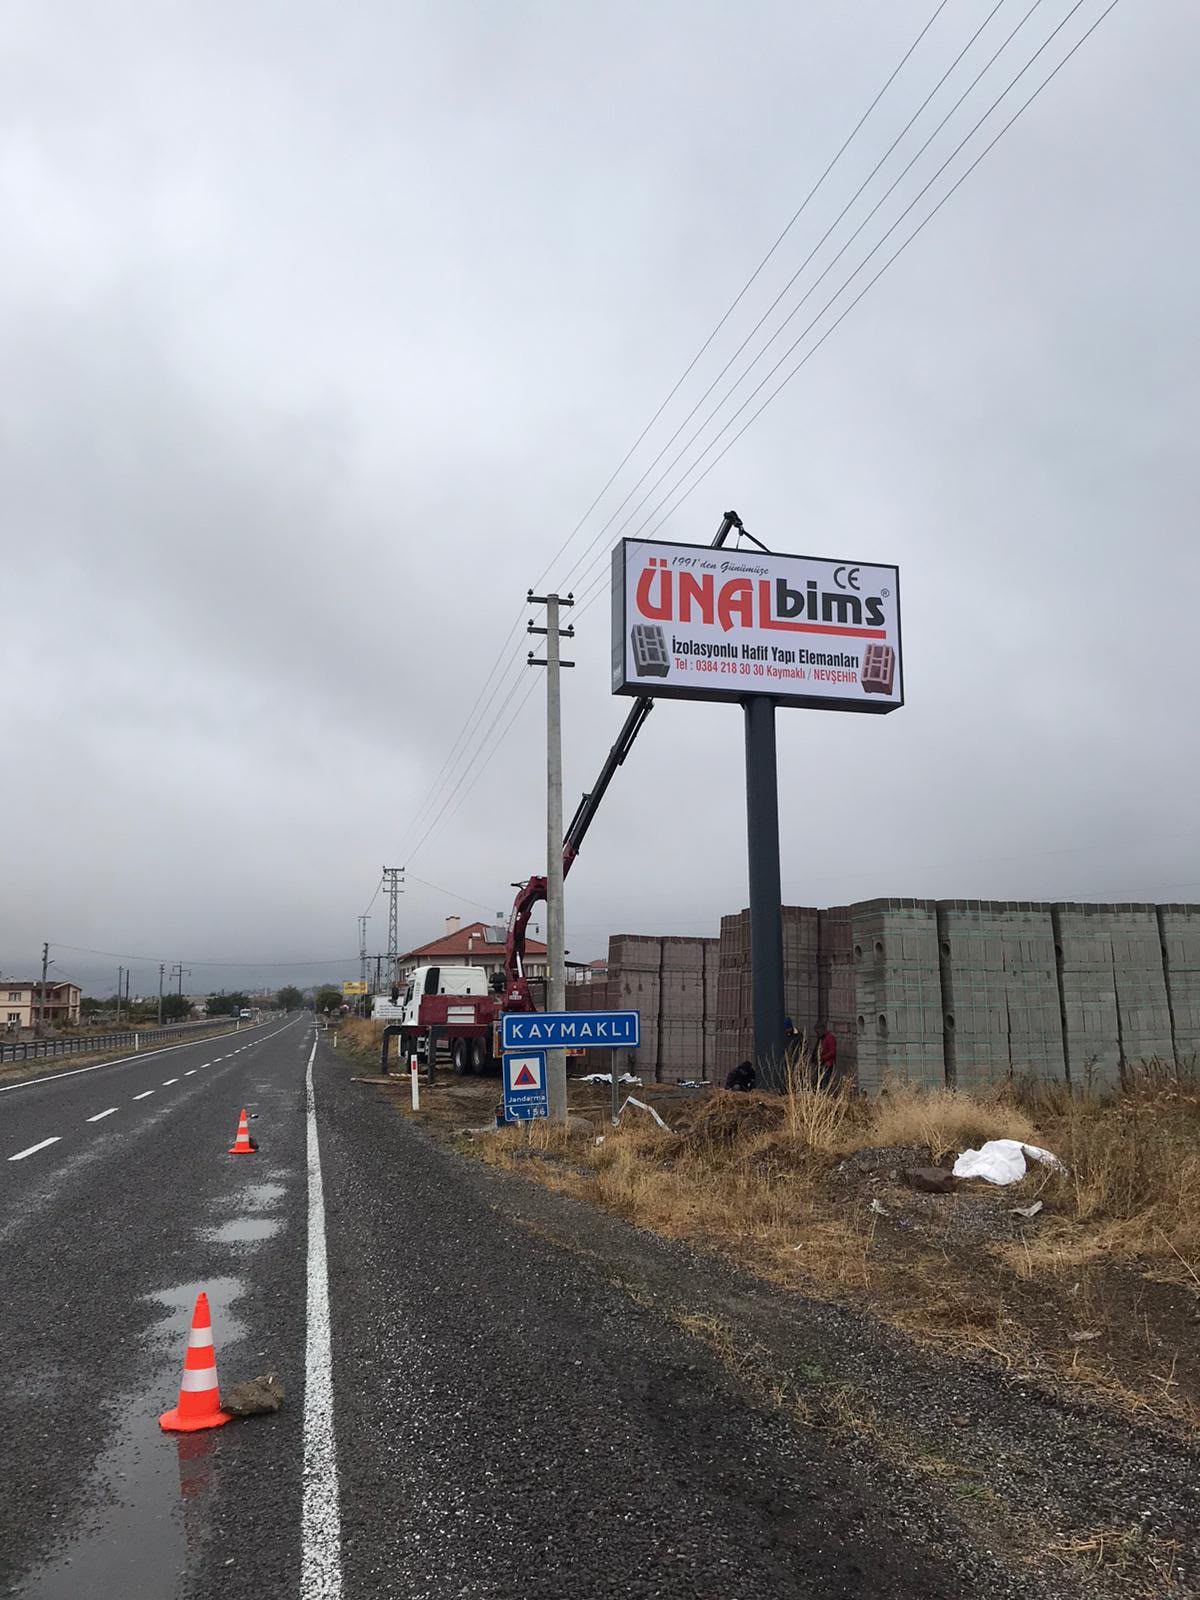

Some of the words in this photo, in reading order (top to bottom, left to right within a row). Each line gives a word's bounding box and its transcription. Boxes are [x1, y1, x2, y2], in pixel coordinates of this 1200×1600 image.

[720, 561, 769, 576] Günümüze
[672, 635, 738, 659] İzolasyonlu
[742, 644, 768, 661] Hafif
[771, 646, 795, 664] Yapı
[799, 649, 859, 668] Elemanları
[675, 658, 688, 670] Tel
[696, 659, 718, 672] 0384
[720, 661, 737, 674] 218
[740, 662, 751, 675] 30
[753, 663, 764, 676] 30
[766, 665, 805, 679] Kaymaklı
[813, 668, 858, 685] NEVŞEHİR
[512, 1021, 630, 1039] KAYMAKLI
[508, 1095, 546, 1103] Jandarma
[527, 1107, 546, 1116] 156
